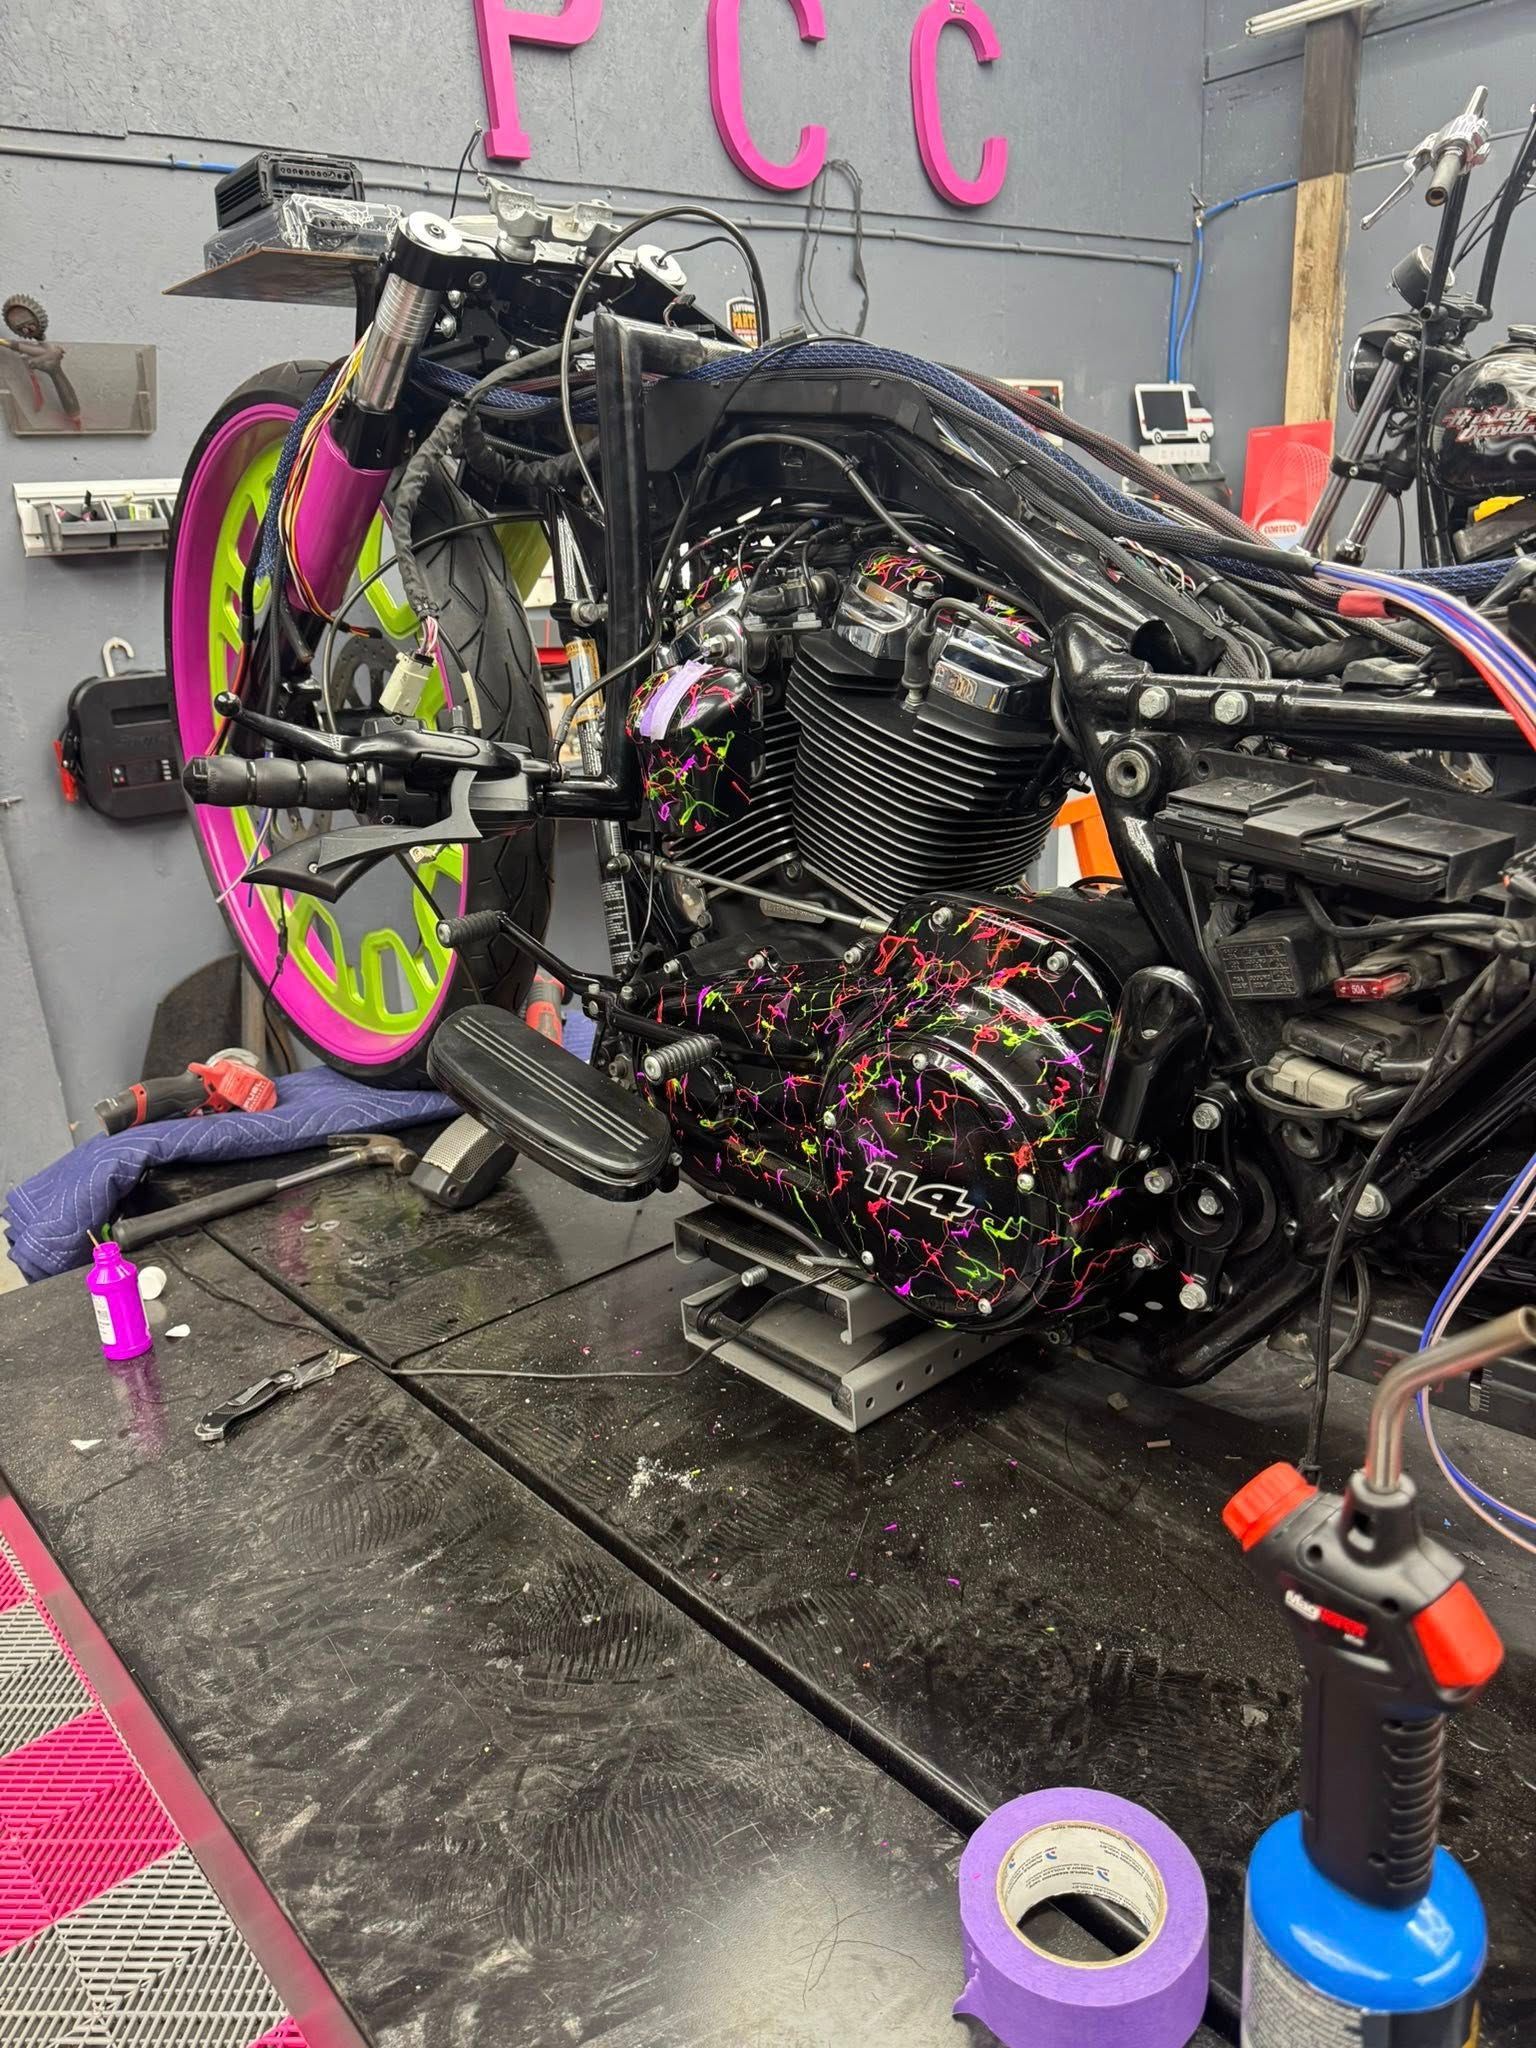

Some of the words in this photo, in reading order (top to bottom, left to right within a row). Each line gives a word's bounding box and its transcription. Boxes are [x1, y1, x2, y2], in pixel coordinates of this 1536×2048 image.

[1351, 984, 1367, 994] 50A
[242, 1081, 264, 1110] FUEL
[864, 1161, 975, 1221] 114
